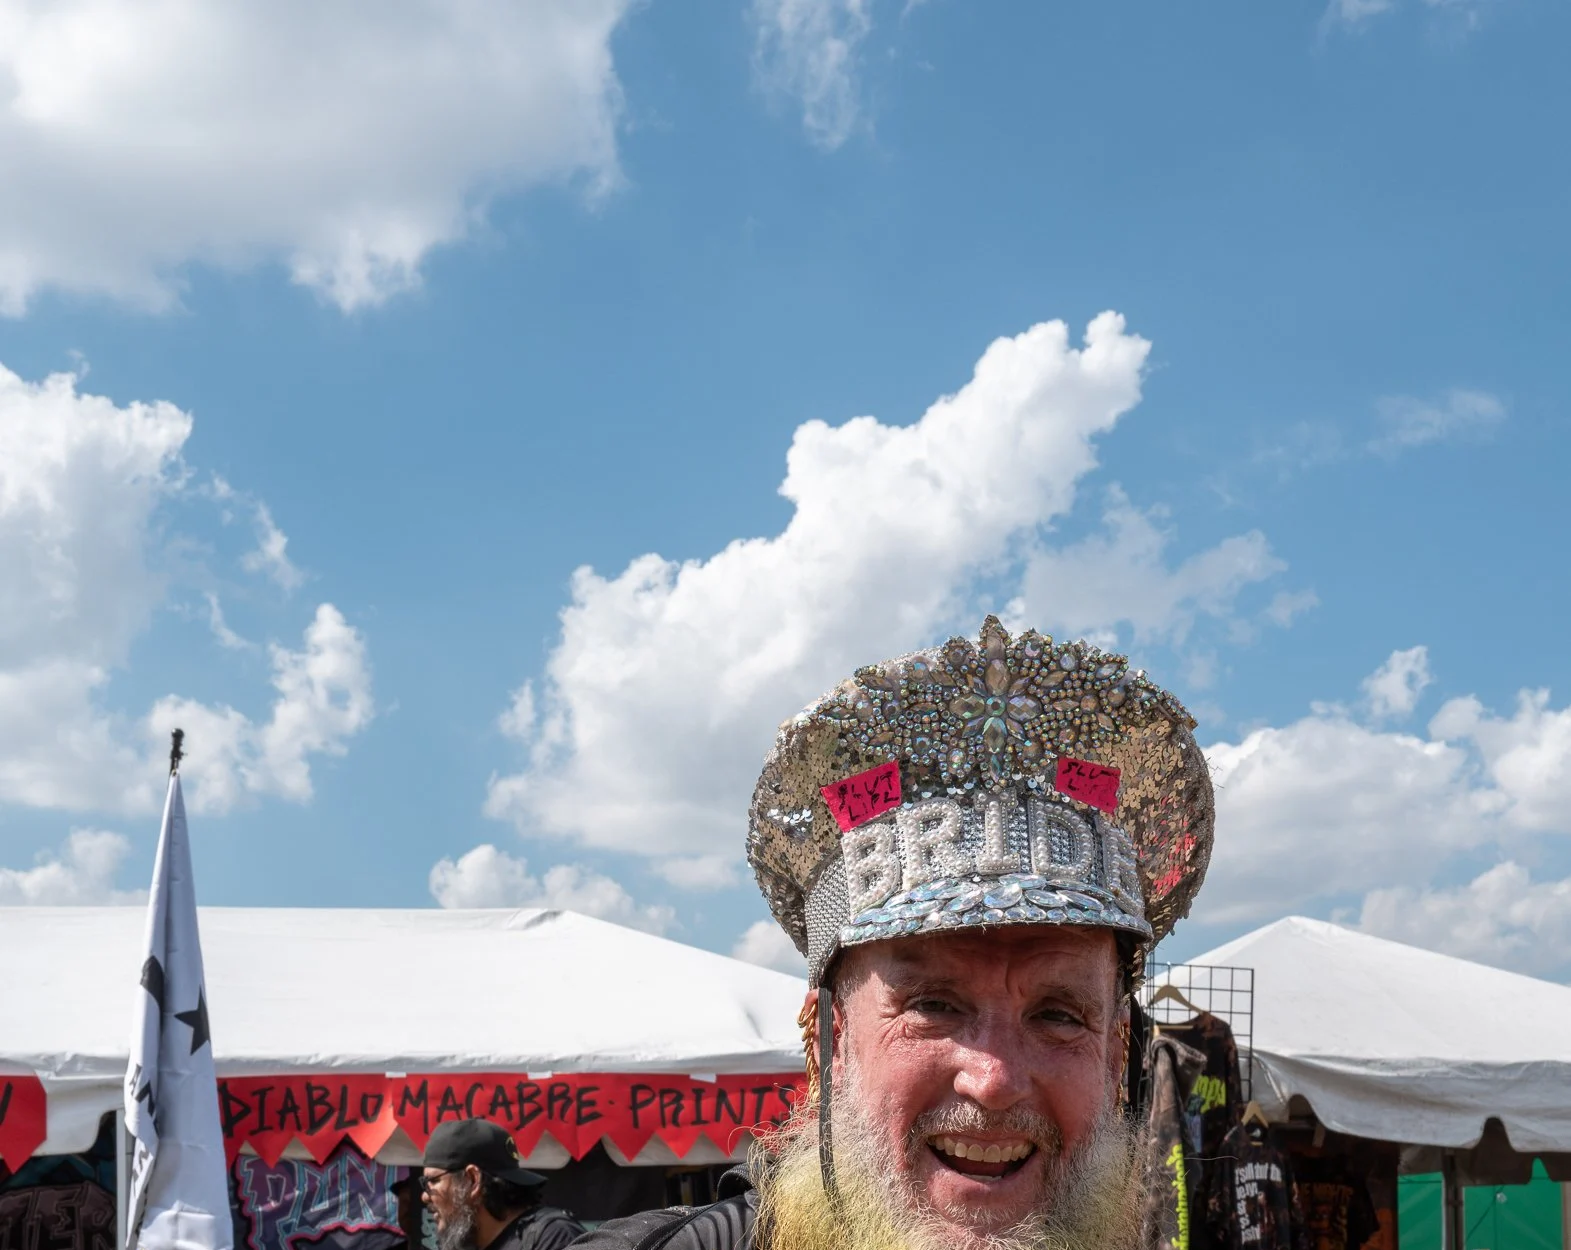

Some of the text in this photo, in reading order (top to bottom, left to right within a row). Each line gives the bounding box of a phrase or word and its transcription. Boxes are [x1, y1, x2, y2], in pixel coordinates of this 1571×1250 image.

[841, 788, 1146, 917] BRIDE
[217, 1081, 384, 1138] DIABLO
[398, 1079, 603, 1134] MACABRE
[630, 1084, 797, 1129] PRINTS
